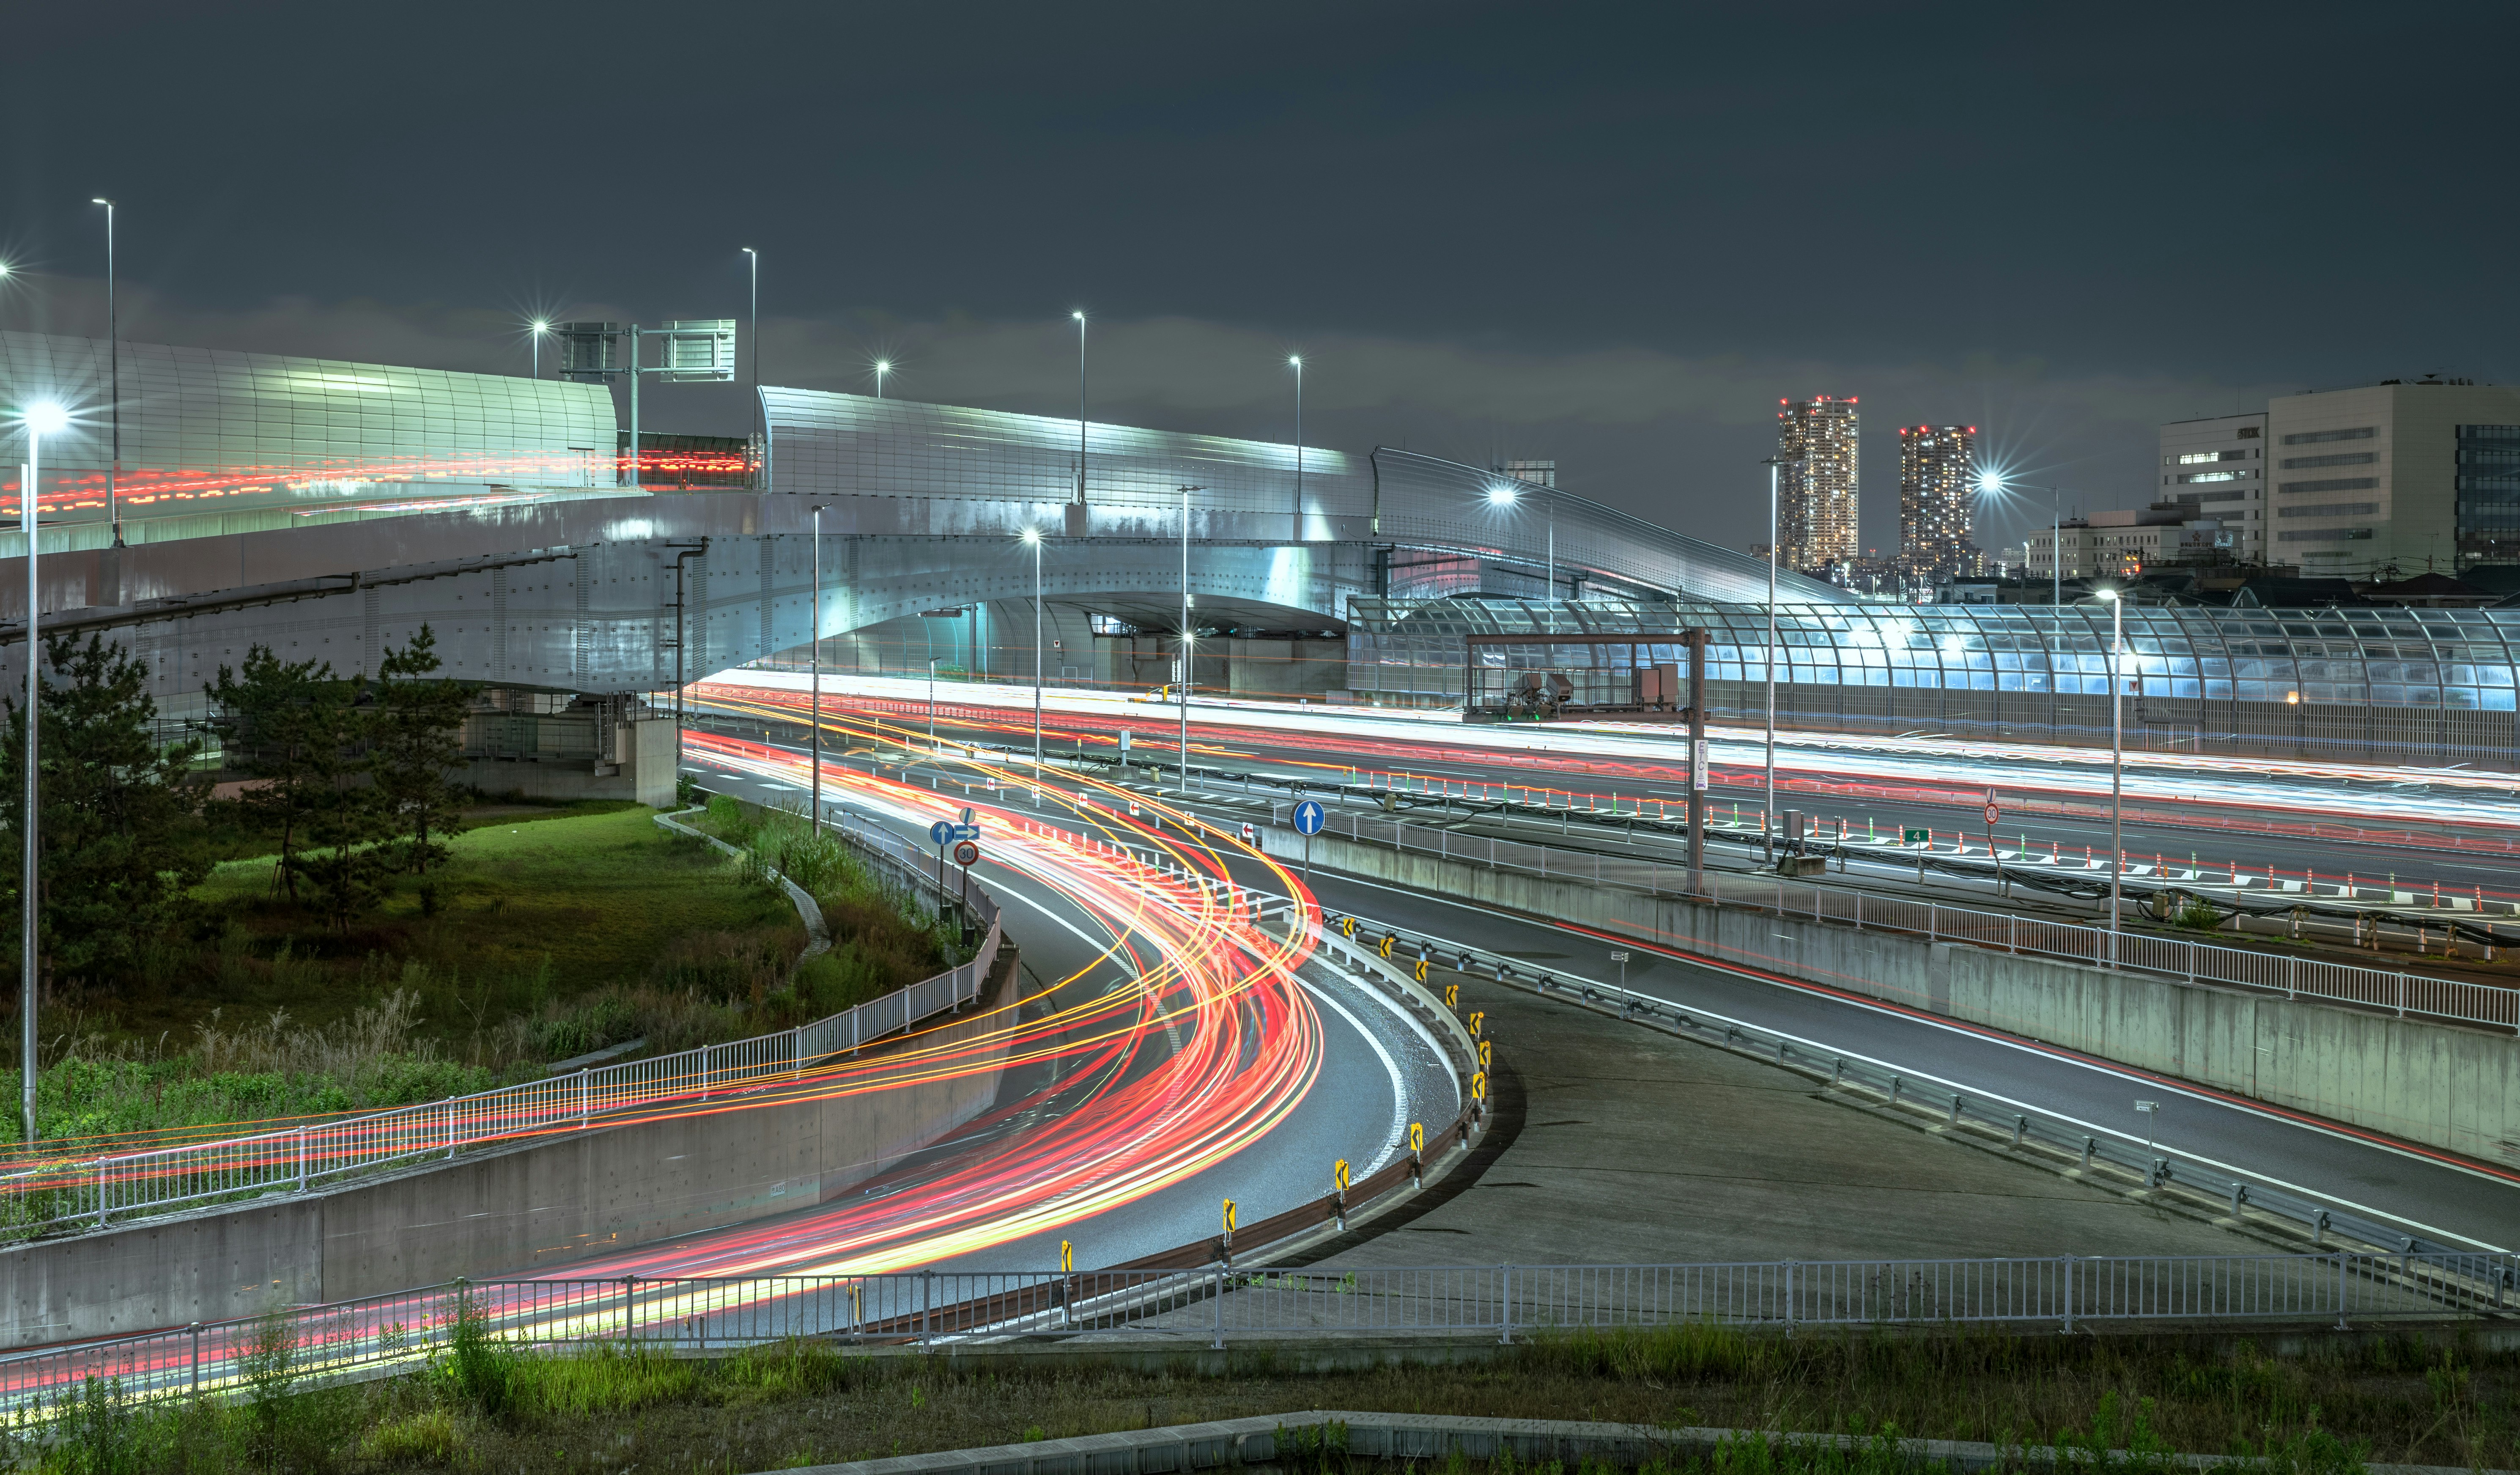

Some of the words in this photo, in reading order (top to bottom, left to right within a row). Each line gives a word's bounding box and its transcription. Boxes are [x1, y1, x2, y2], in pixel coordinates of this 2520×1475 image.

[2241, 426, 2260, 439] TDK
[1988, 809, 1996, 819] 30
[1913, 831, 1920, 840] 4
[960, 848, 973, 859] 30
[771, 1184, 785, 1194] 市A80
